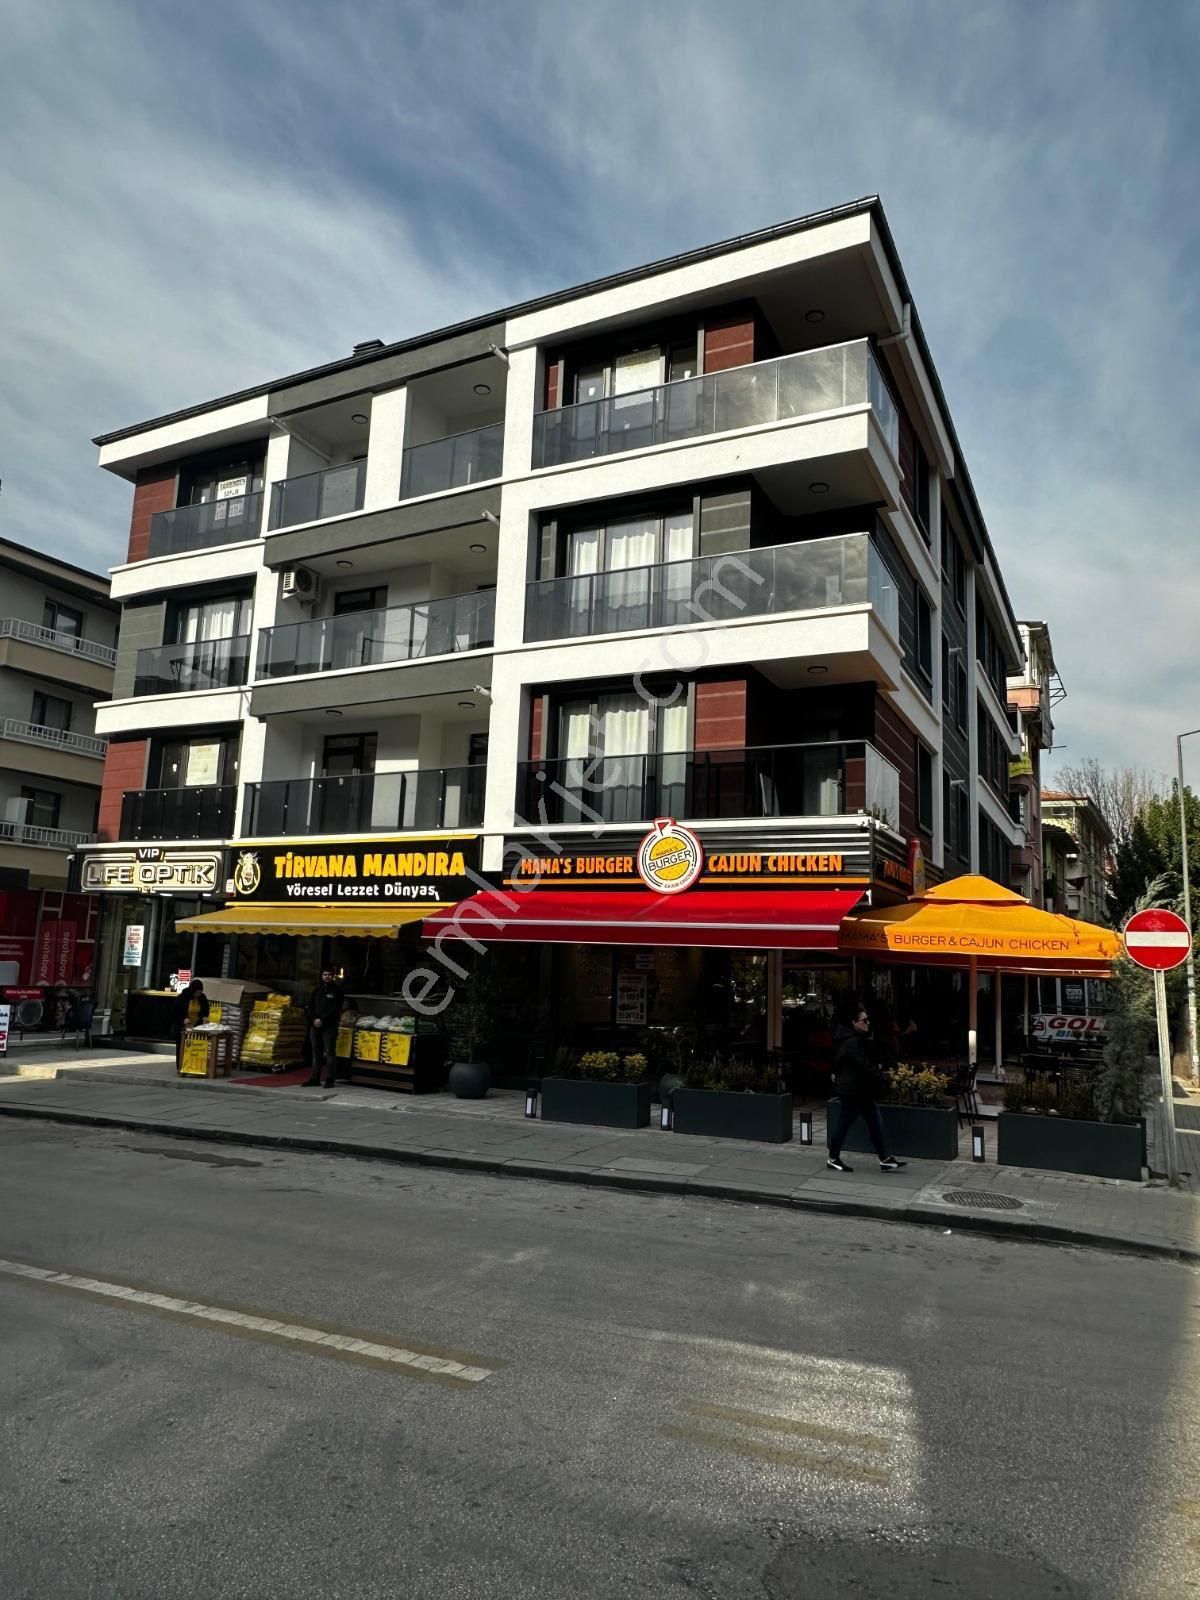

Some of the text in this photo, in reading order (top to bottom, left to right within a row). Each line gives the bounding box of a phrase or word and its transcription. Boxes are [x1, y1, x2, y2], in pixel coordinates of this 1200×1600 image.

[138, 848, 159, 858] VIP
[648, 850, 692, 871] BURGER
[708, 853, 842, 872] CAJUN CHICKEN
[87, 864, 134, 883] LIFE
[363, 852, 466, 877] MANDIRA
[521, 856, 633, 875] MAMA'S BURGER
[286, 883, 333, 896] Yöresel
[337, 884, 379, 896] Lezzet
[840, 932, 1069, 950] MAMA'S BURGER & CAJUN CHICKEN
